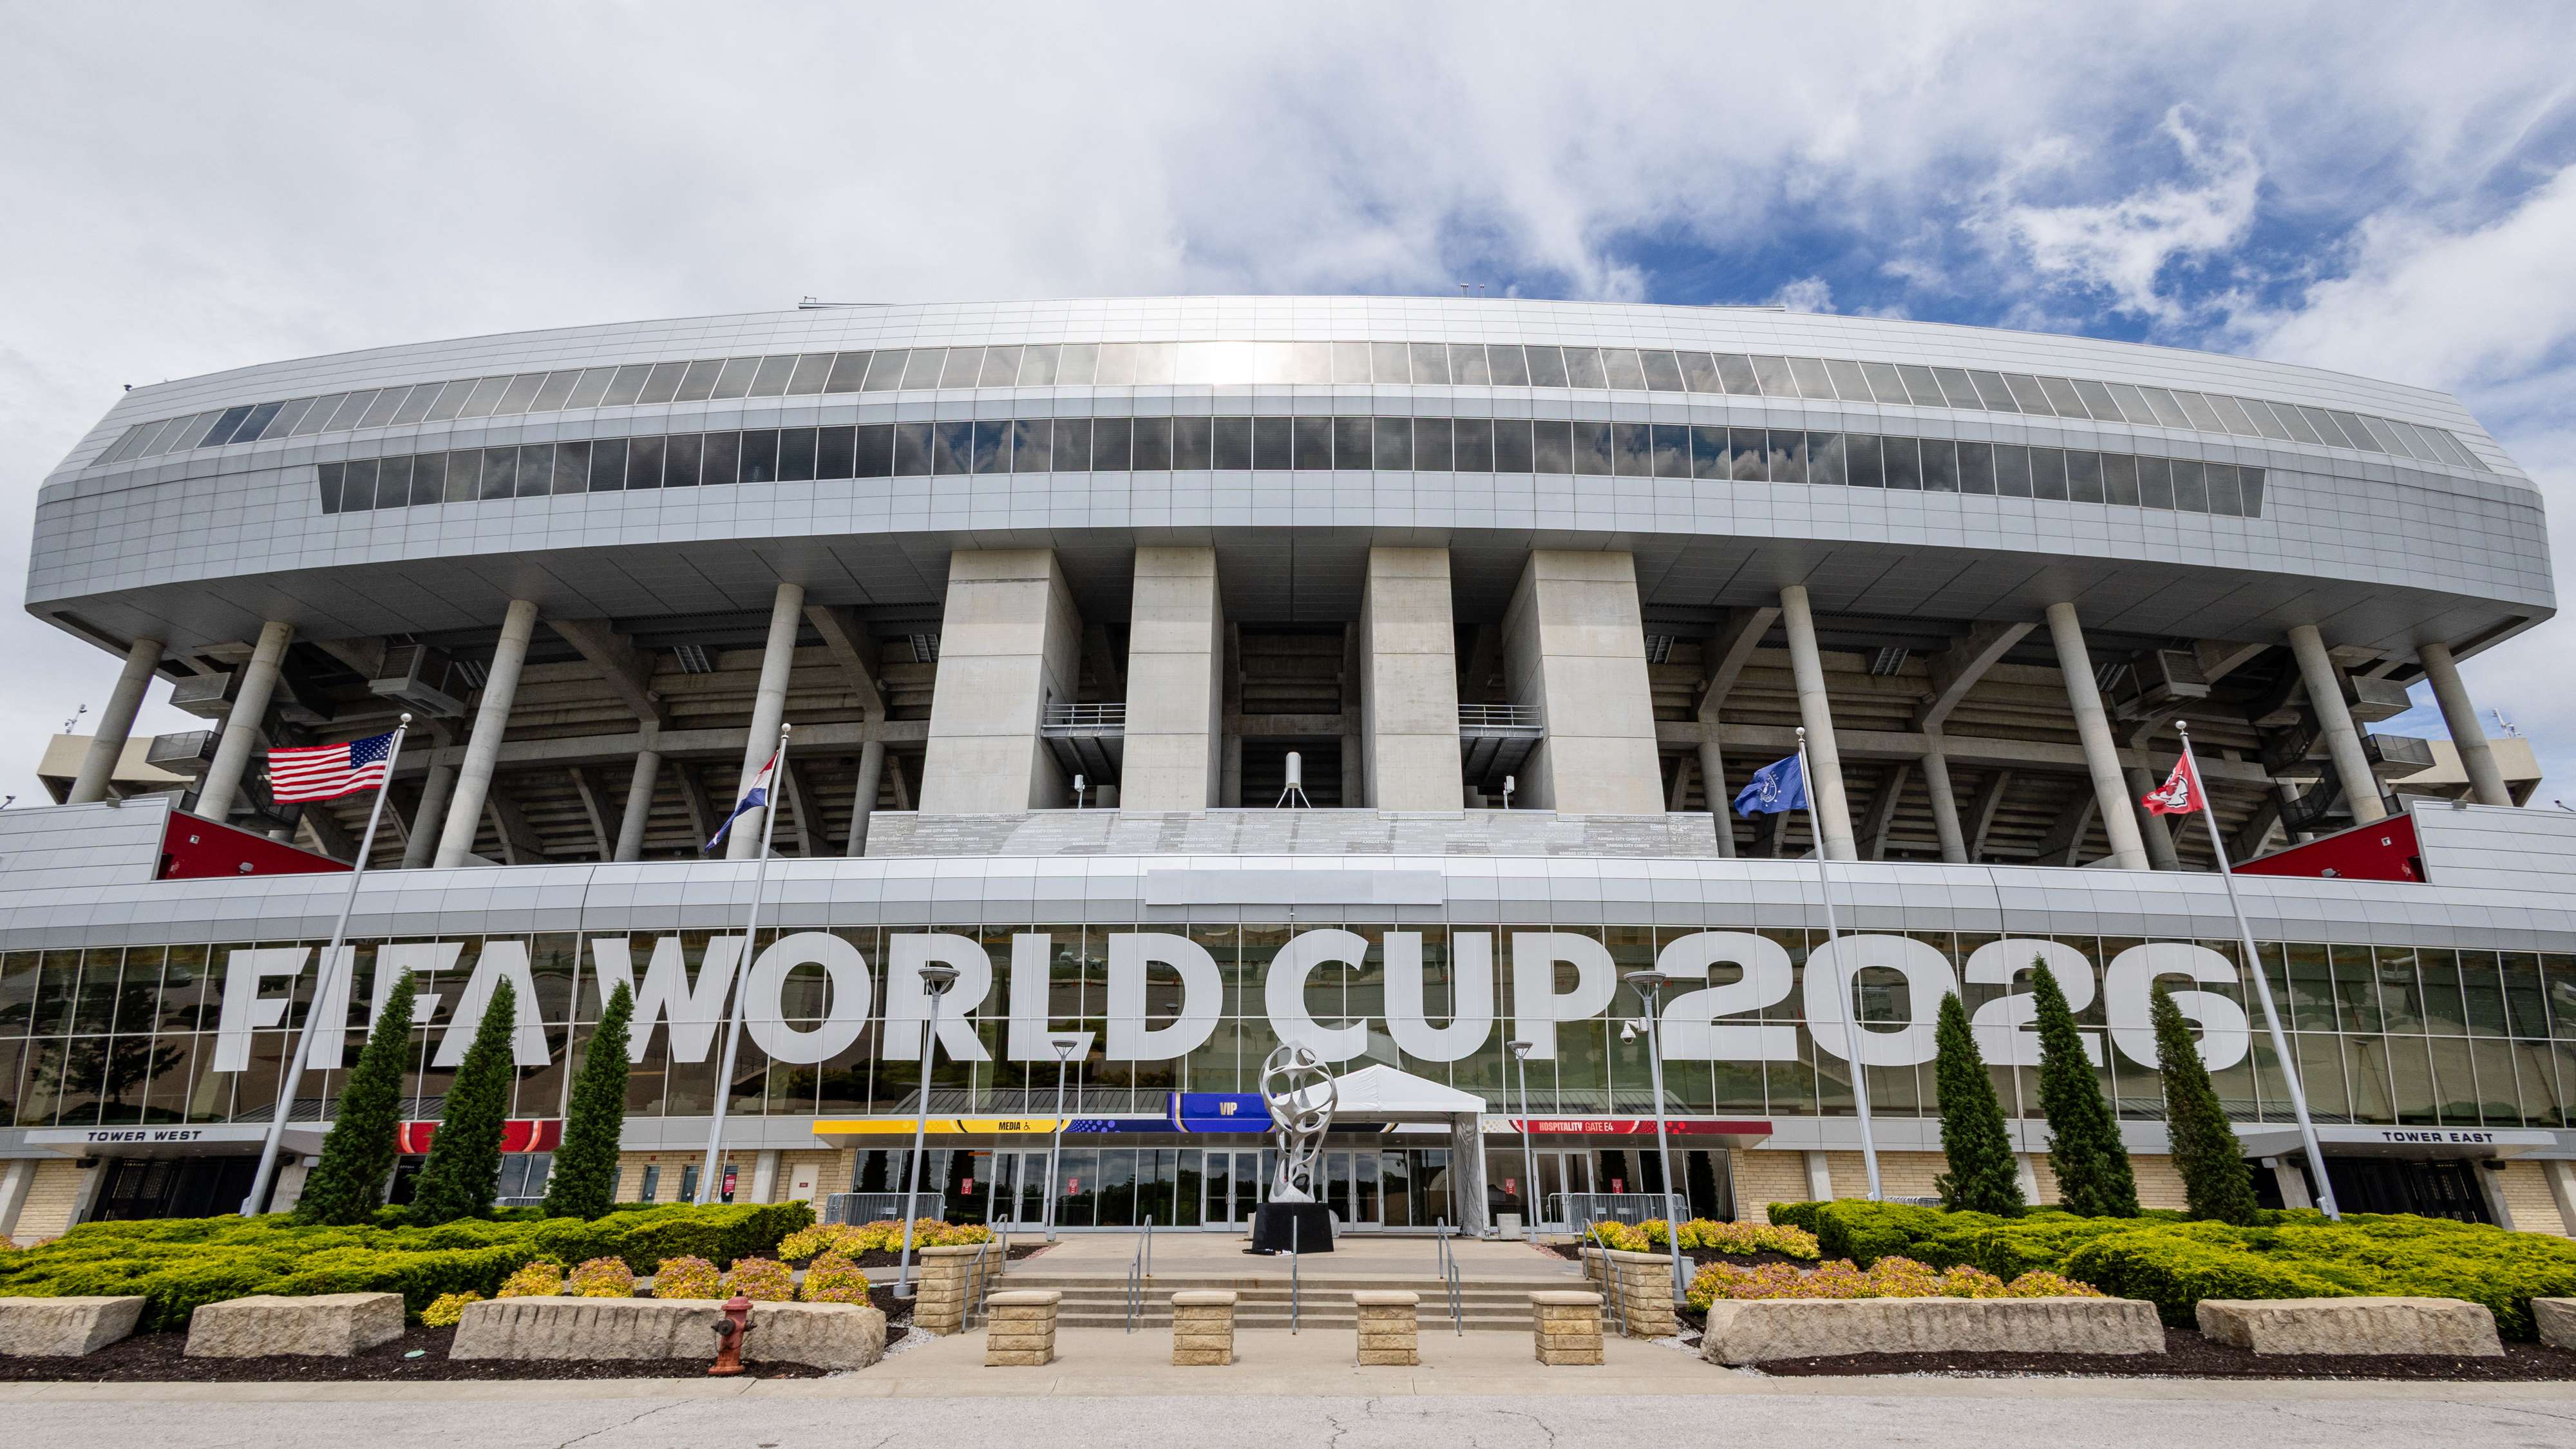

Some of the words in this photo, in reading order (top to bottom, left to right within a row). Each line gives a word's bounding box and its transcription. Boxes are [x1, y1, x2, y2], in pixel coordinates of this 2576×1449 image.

[213, 941, 551, 1072] FIFA
[591, 931, 1223, 1064] WORLD
[1265, 929, 1616, 1063] CUP
[1657, 931, 2249, 1072] 2026
[1219, 1103, 1238, 1116] VIP
[999, 1122, 1021, 1130] MEDIA
[1539, 1122, 1582, 1132] HOSPITALITY
[1586, 1122, 1603, 1132] GATE
[1604, 1122, 1614, 1132] E4
[88, 1132, 146, 1141] TOWER
[155, 1131, 202, 1140] WEST
[2382, 1132, 2443, 1142] TOWER
[2450, 1133, 2493, 1142] EAST
